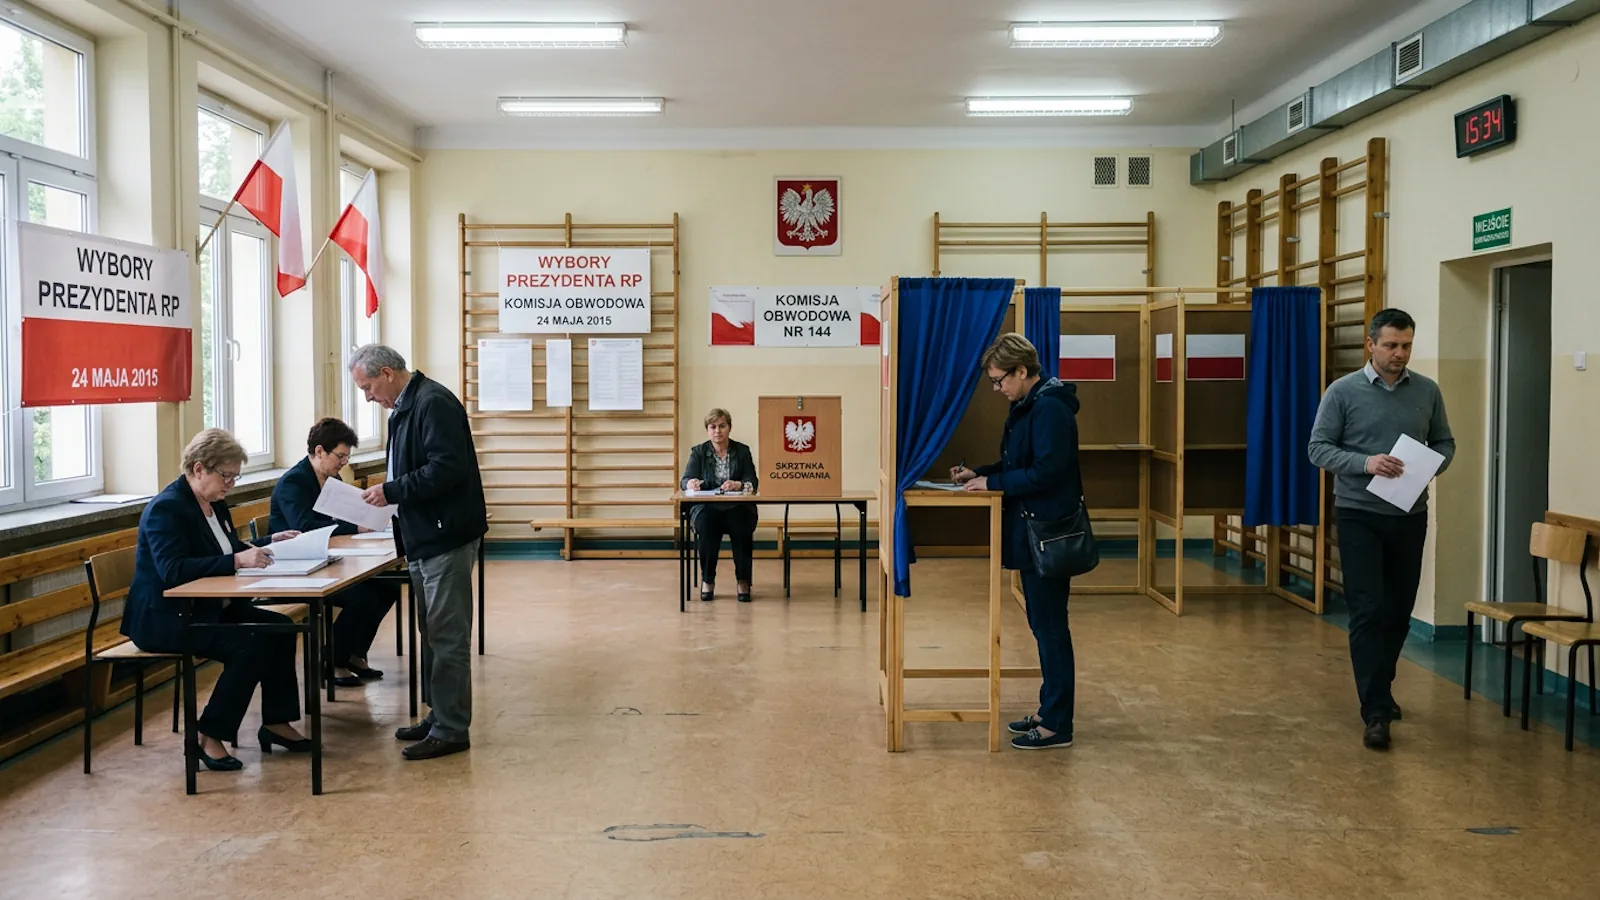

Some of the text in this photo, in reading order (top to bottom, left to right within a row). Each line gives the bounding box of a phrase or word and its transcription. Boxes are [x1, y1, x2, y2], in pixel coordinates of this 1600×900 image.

[77, 247, 153, 281] WYBORY
[538, 256, 611, 269] WYBORY
[507, 274, 643, 288] PREZYDENTA RP
[38, 280, 180, 318] PREZYDENTA RP
[504, 298, 645, 309] KOMISJA OBWODOWA
[775, 294, 839, 307] KOMISJA
[536, 316, 612, 326] 24 MAJA 2015
[763, 310, 852, 322] OBWODOWA
[784, 326, 831, 337] NR 144
[71, 367, 159, 388] 24 MAJA 2015
